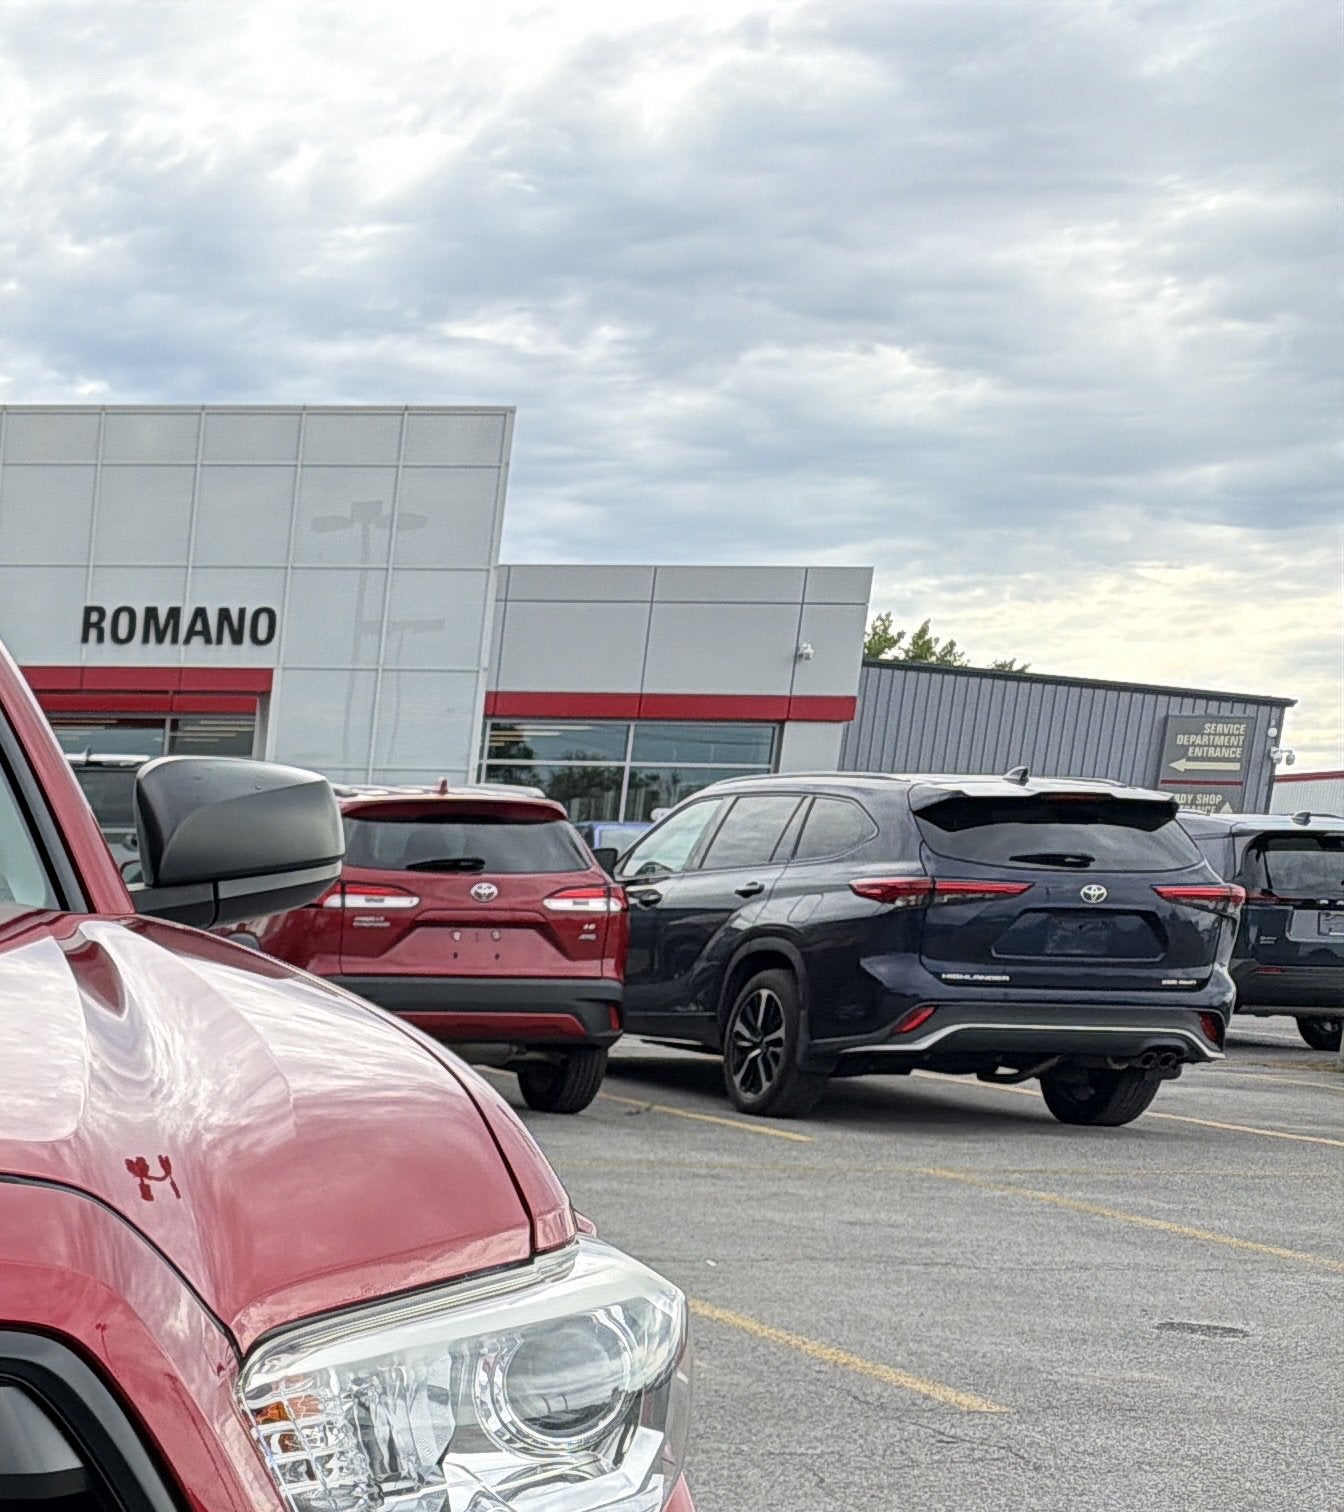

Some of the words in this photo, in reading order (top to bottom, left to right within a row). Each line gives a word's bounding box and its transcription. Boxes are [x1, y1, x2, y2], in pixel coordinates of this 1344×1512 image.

[80, 605, 277, 646] ROMANO
[1204, 723, 1247, 735] SERVICE
[1176, 734, 1245, 747] DEPARTMENT
[1188, 746, 1243, 758] ENTRANCE
[1196, 793, 1223, 805] SHOP
